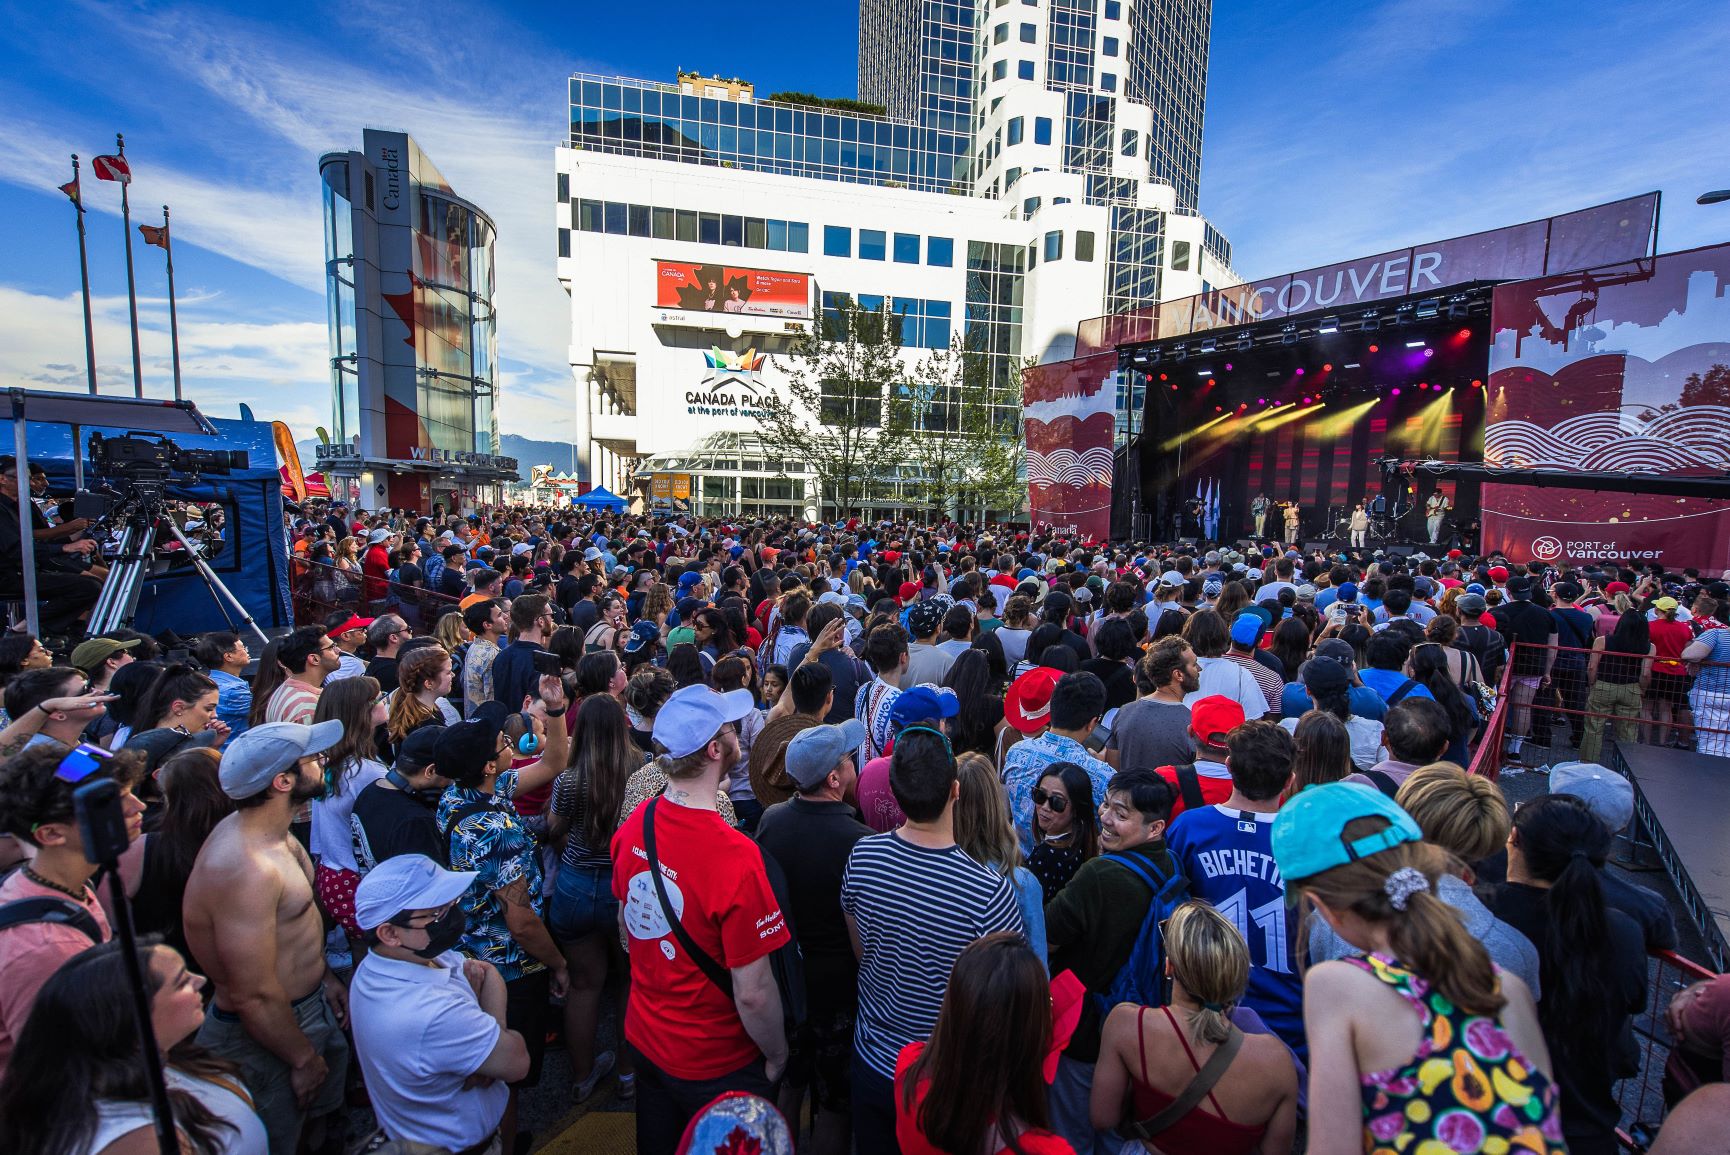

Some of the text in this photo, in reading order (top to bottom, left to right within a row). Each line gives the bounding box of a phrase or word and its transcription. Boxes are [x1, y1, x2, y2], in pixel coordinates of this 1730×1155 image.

[383, 148, 399, 210] Canada
[1172, 252, 1442, 333] VANCOUVER
[685, 391, 780, 408] CANADA PLACE
[687, 406, 696, 415] at
[697, 406, 710, 415] the
[711, 407, 729, 418] port
[730, 407, 738, 416] of
[410, 446, 496, 466] WELCOME
[1045, 522, 1077, 535] Canada
[1566, 541, 1616, 550] PORT of
[1566, 549, 1664, 559] vancouver
[1198, 849, 1286, 890] BICHETT
[760, 918, 785, 939] SONY
[1214, 886, 1294, 974] 11
